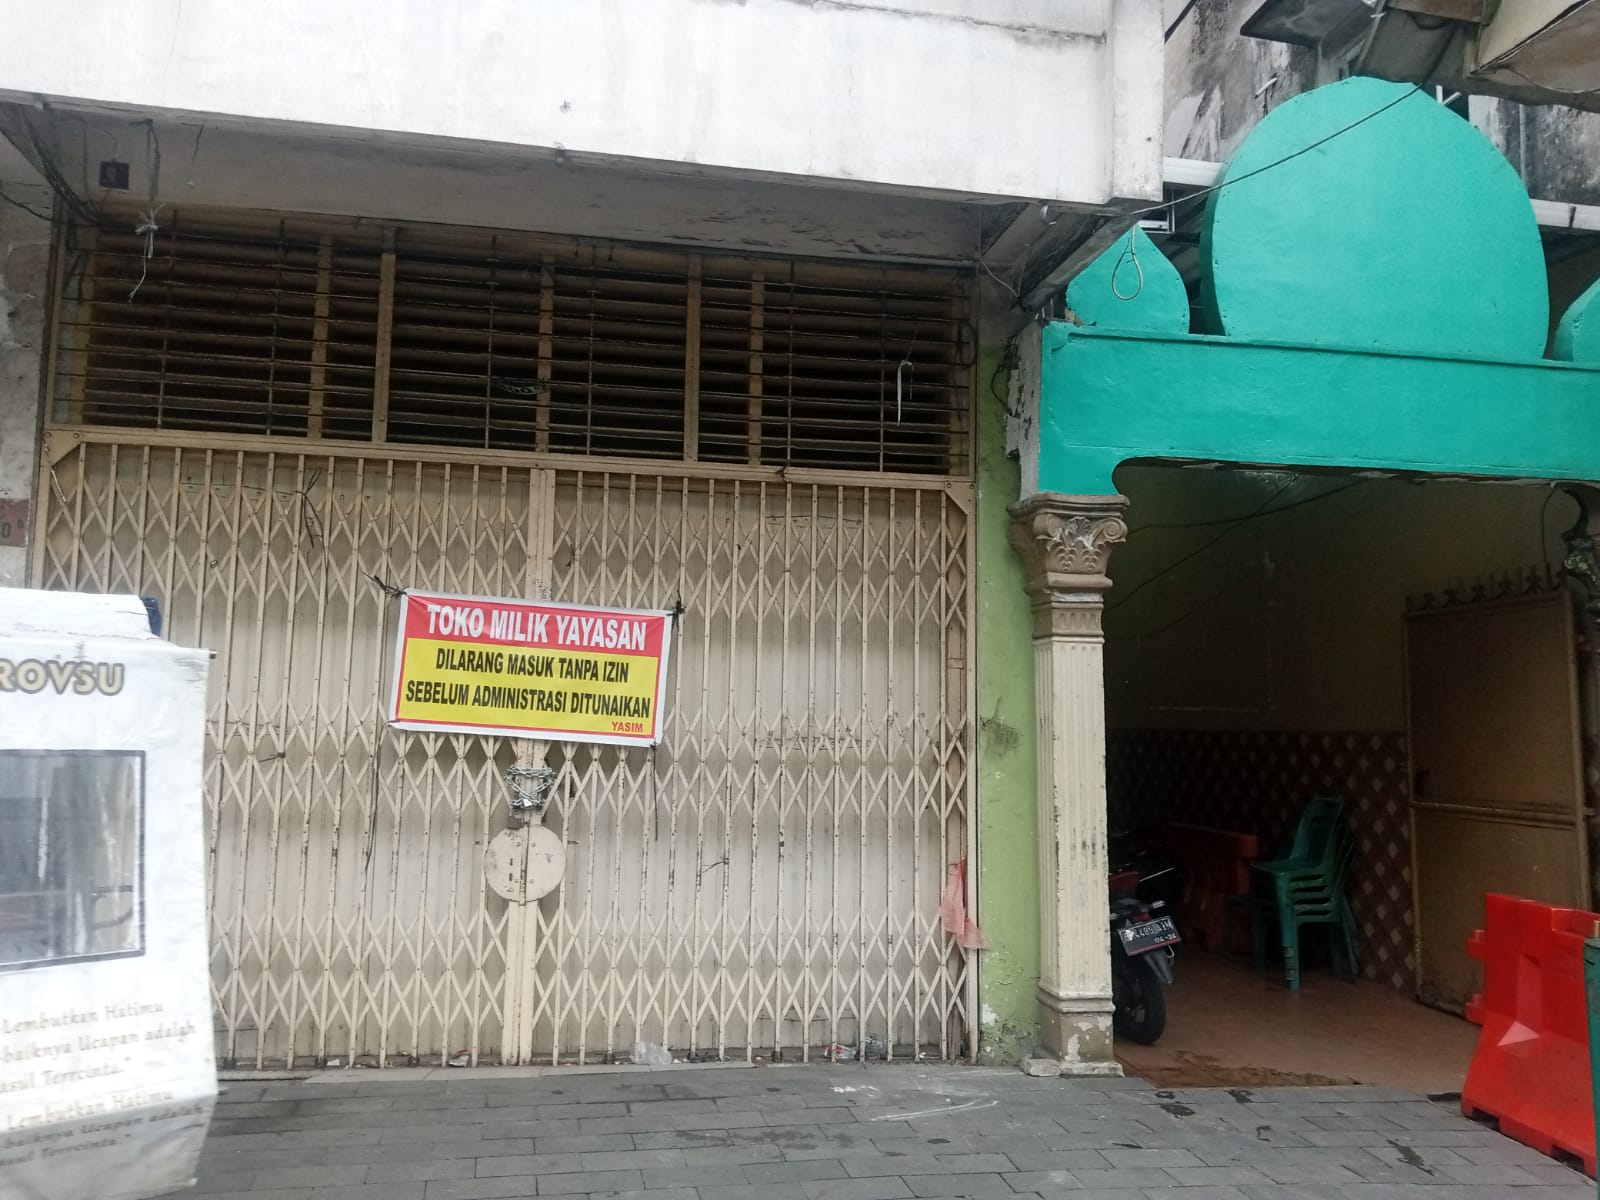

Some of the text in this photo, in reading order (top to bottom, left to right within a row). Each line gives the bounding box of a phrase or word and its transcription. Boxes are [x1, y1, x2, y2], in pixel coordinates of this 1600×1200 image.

[427, 604, 648, 651] TOKO MILIK YAYASAN
[435, 647, 630, 683] DILARANG MASUK TANPA IZIN
[405, 680, 651, 719] SEBELUM ADMINISTRASI DITUNAIKAN
[611, 720, 644, 734] YASIM
